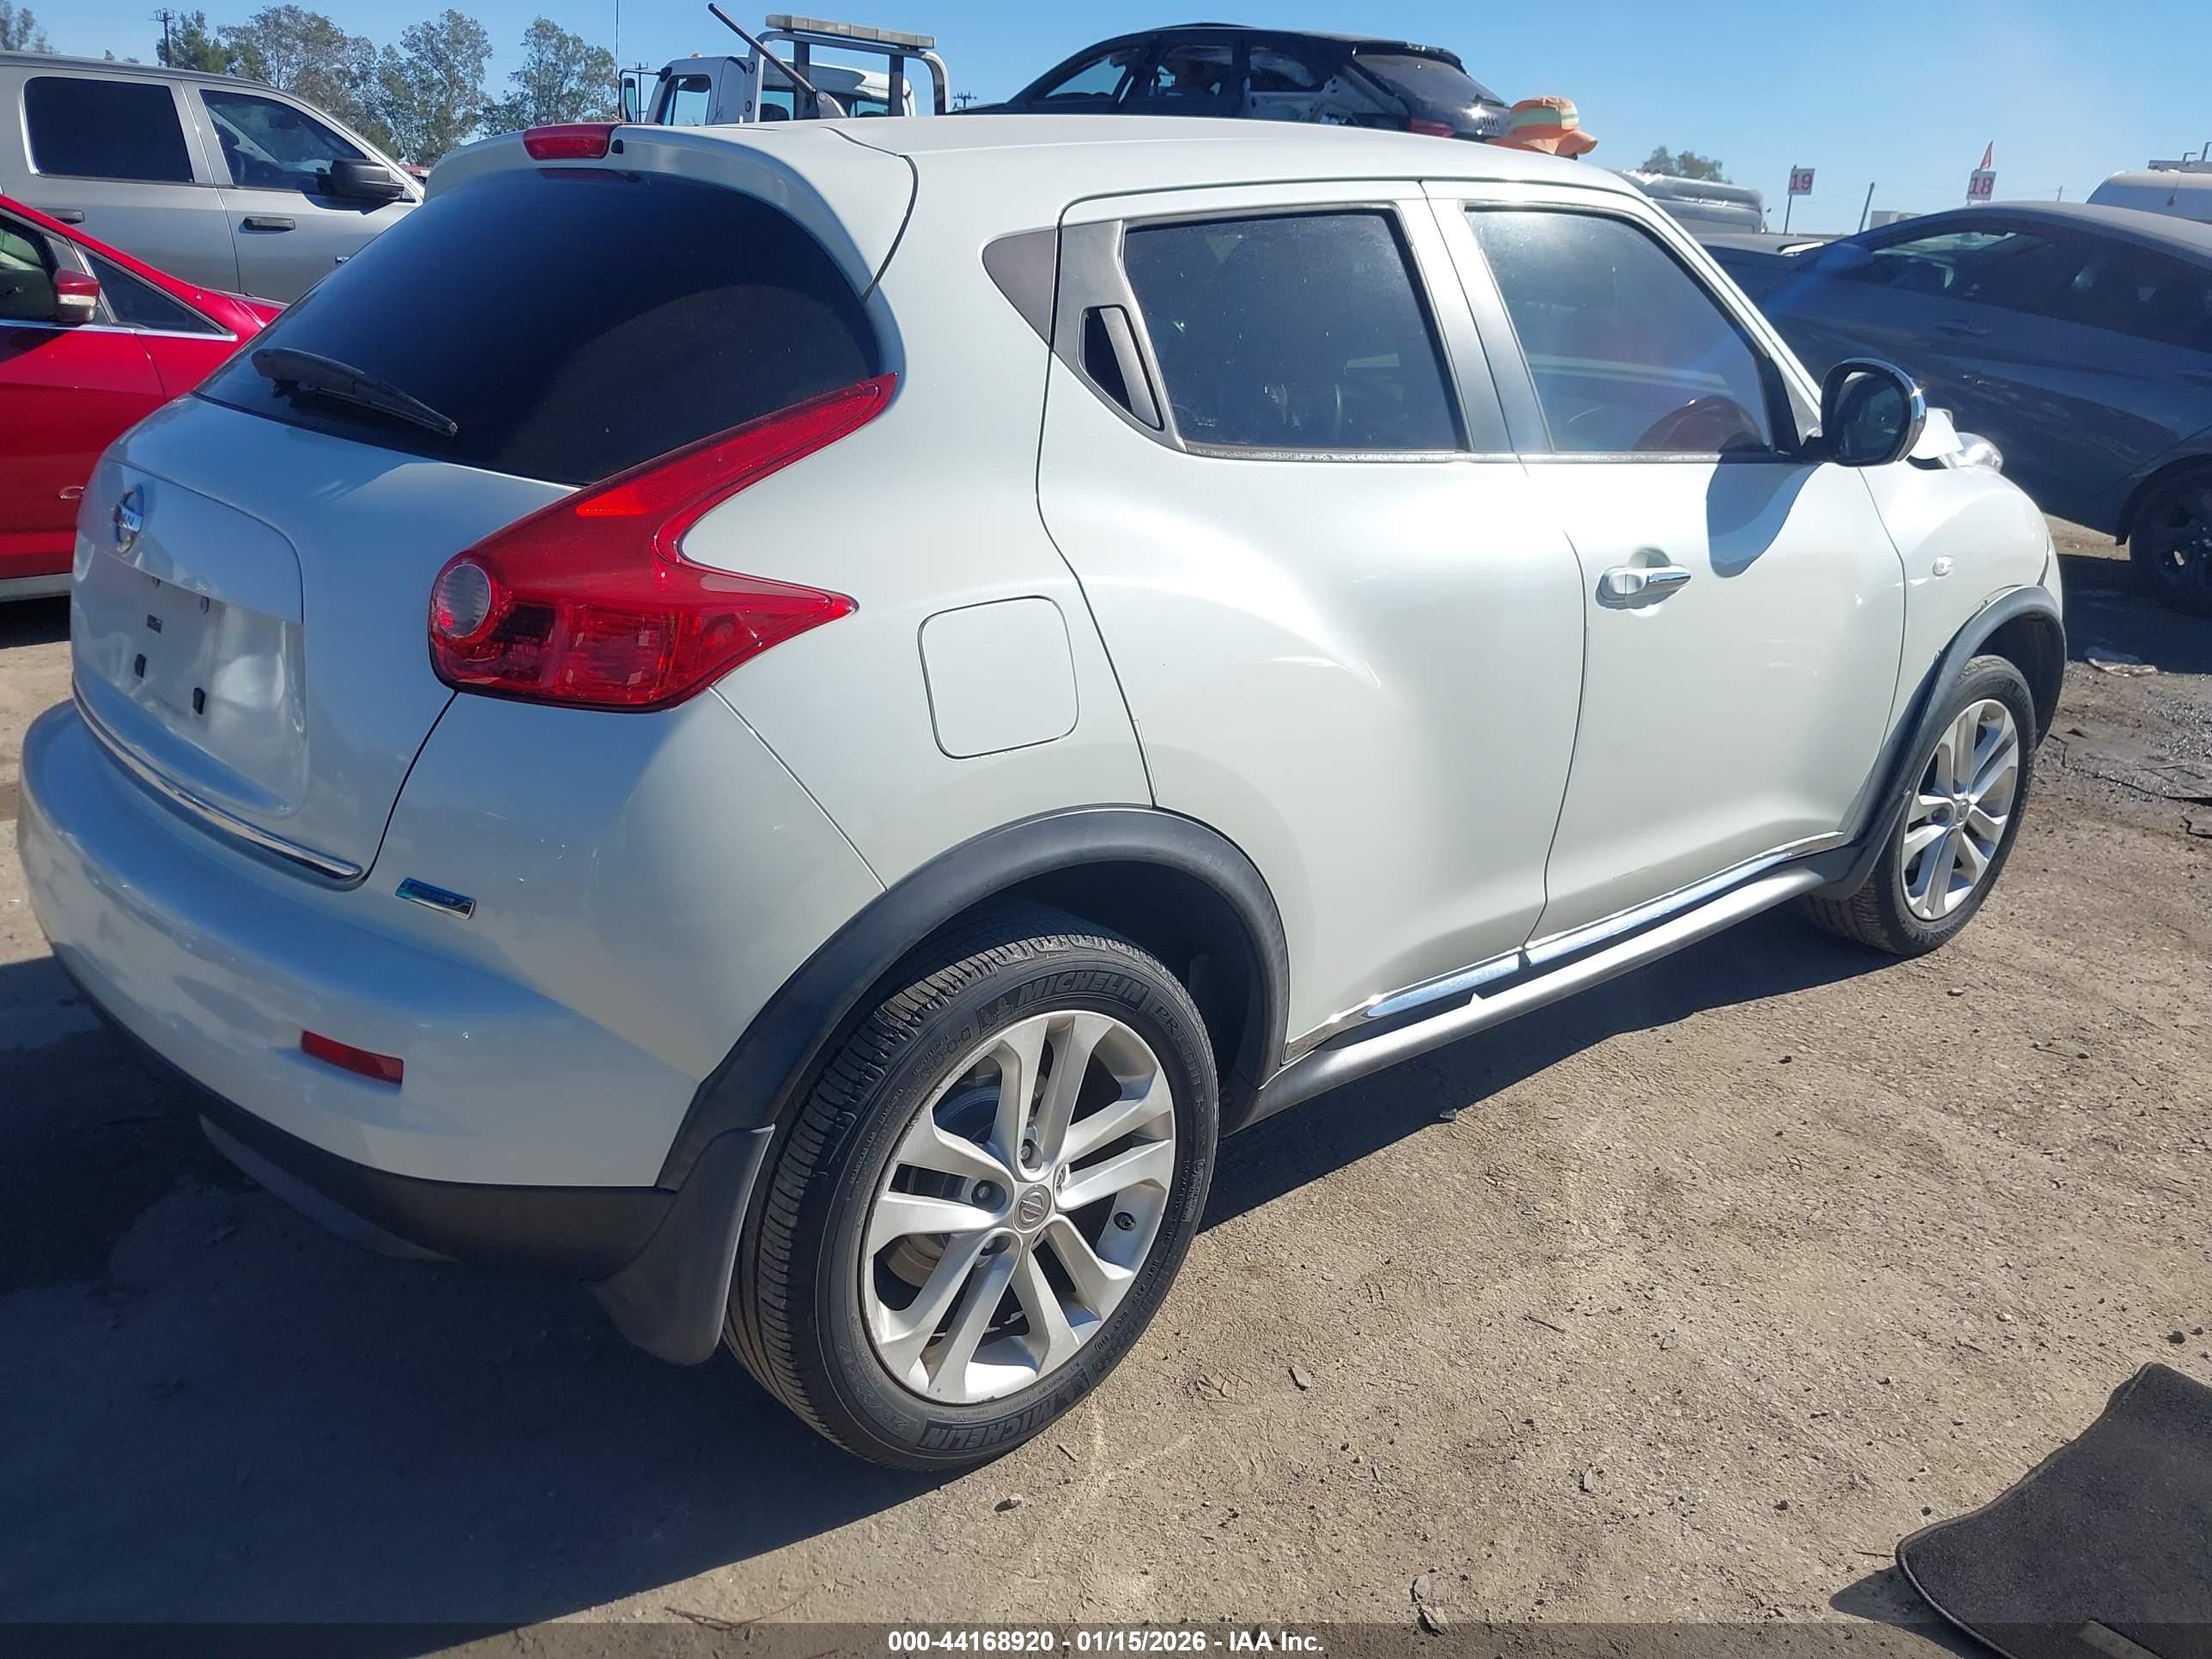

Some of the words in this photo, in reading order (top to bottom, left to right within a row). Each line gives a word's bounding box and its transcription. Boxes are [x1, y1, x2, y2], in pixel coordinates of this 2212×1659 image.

[1790, 173, 1814, 191] 19
[1969, 177, 1992, 196] 18
[1019, 970, 1149, 1007] MICHELIN
[1153, 1004, 1206, 1114] PREMIER
[923, 1396, 1055, 1449] MICHELIN
